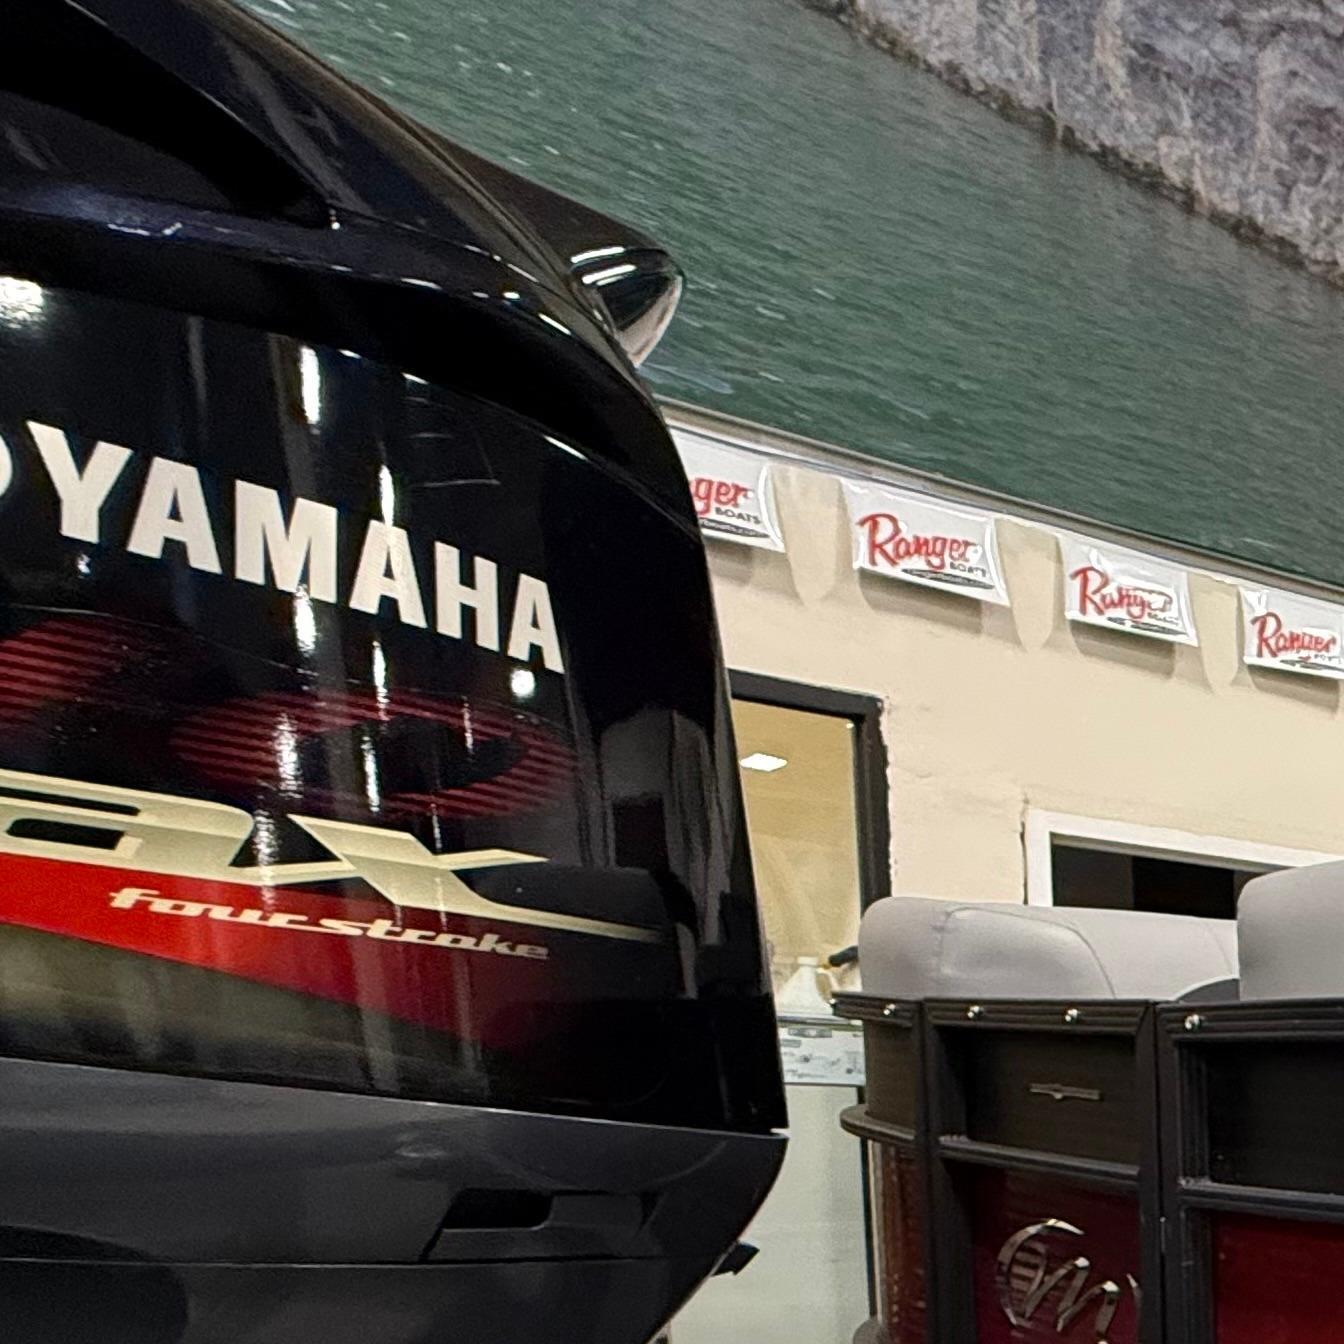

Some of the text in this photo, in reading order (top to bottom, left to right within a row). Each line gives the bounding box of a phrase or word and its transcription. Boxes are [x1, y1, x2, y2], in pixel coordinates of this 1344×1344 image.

[714, 506, 762, 525] BOATS
[857, 512, 979, 572] Ranger
[26, 420, 565, 674] YAMAHA
